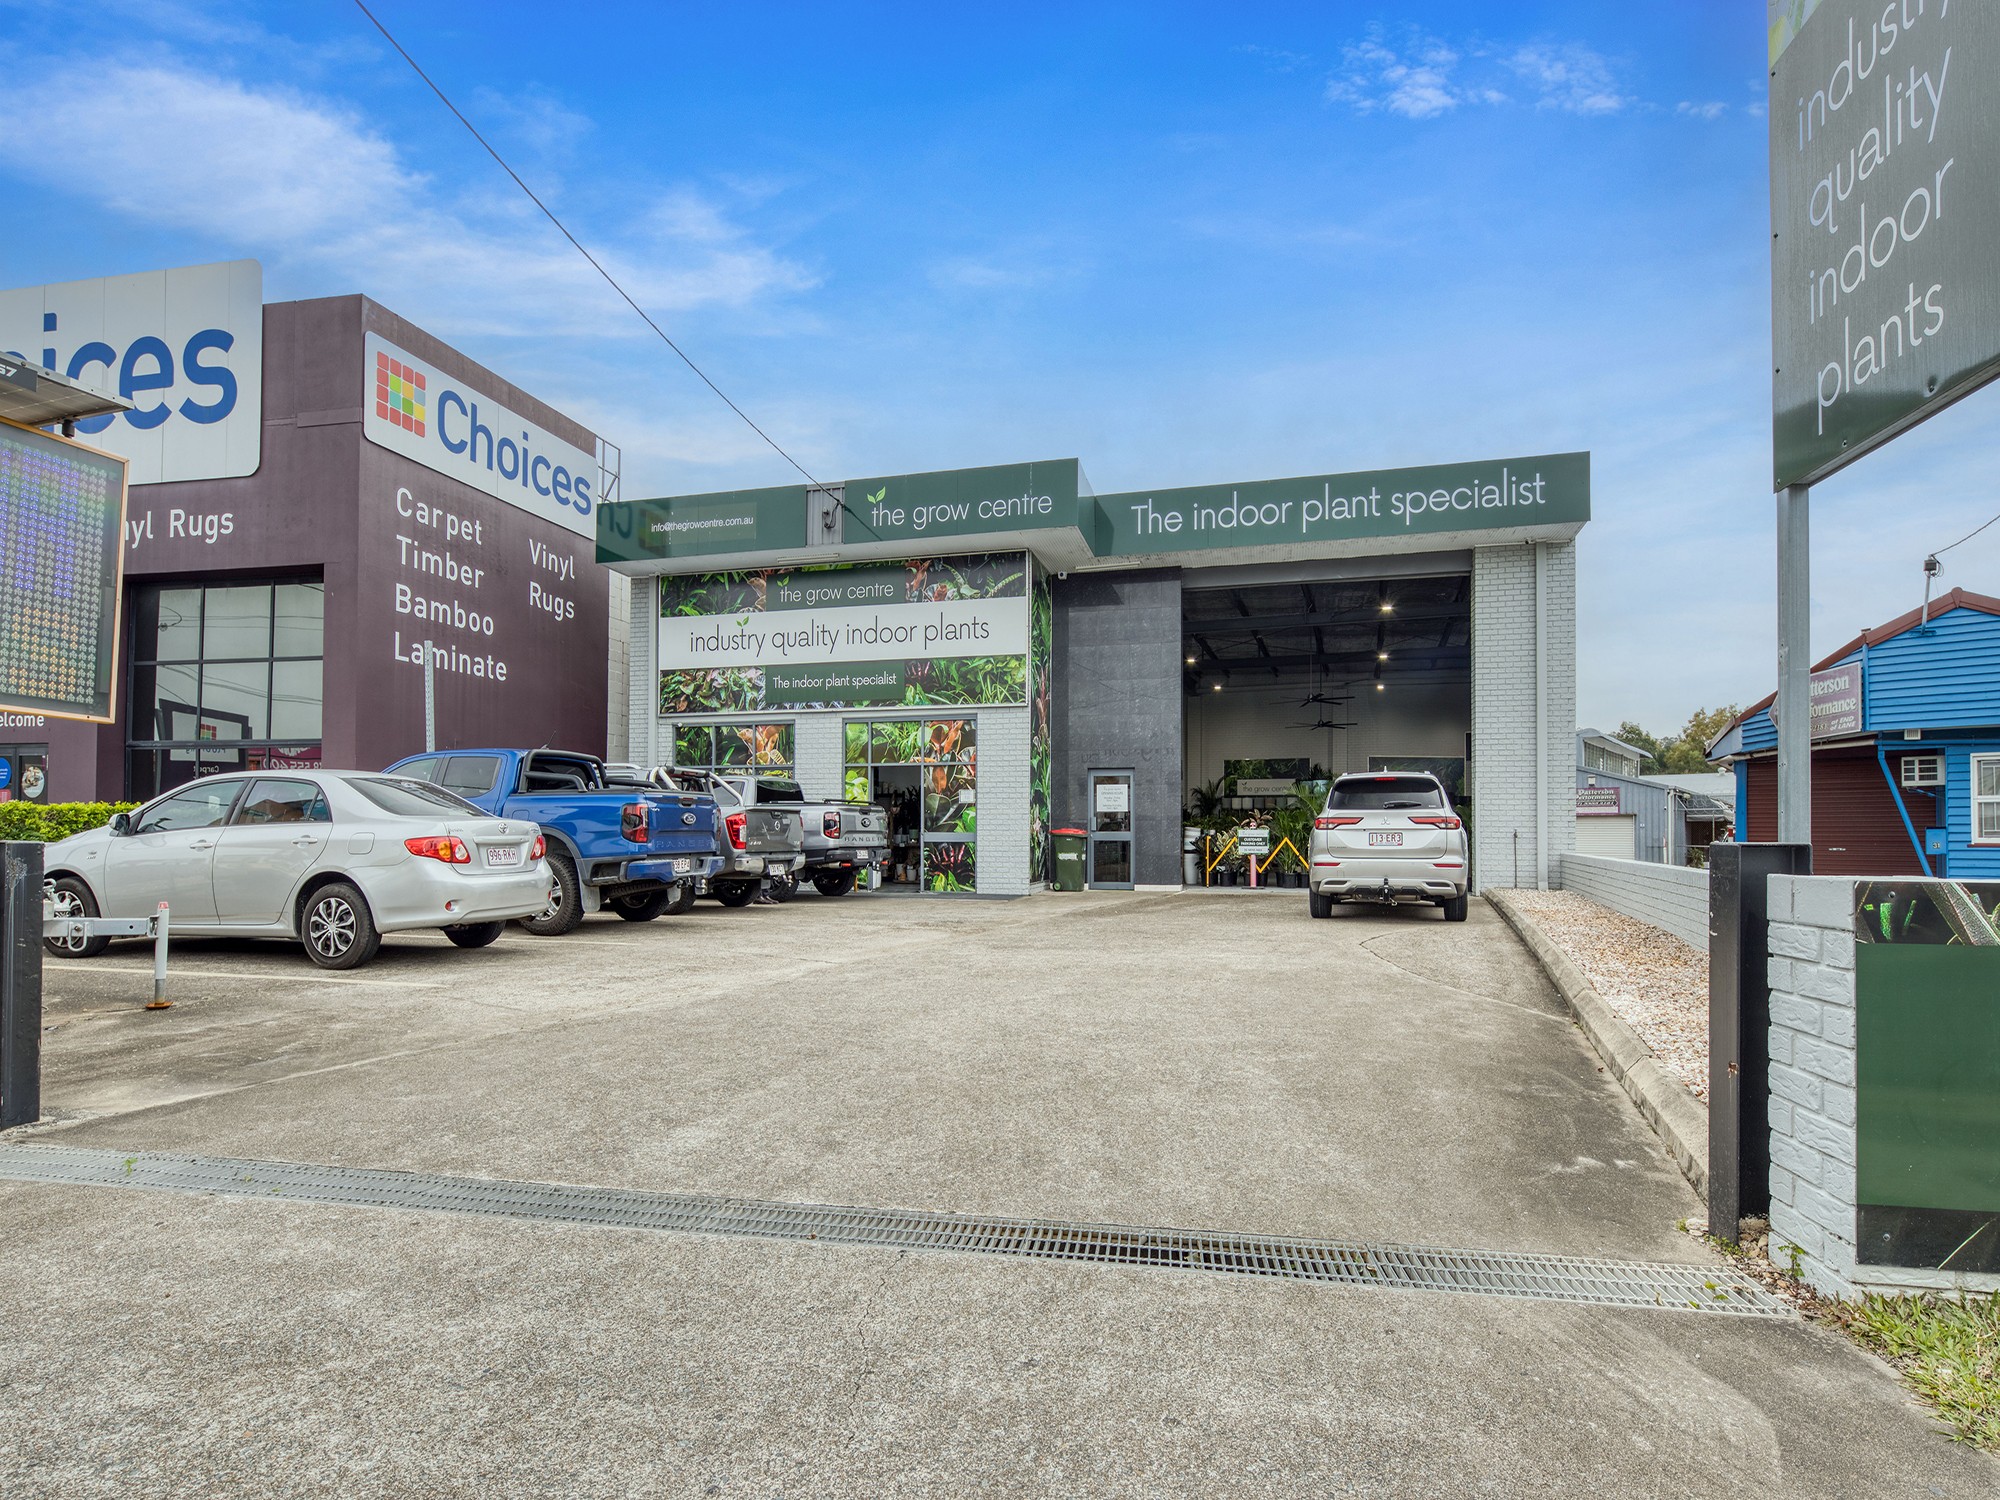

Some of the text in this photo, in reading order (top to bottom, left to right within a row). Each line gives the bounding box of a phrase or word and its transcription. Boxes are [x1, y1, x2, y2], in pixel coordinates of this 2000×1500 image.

[1809, 46, 1952, 233] quality
[1809, 157, 1954, 325] indoor
[4, 312, 238, 434] ices
[1817, 282, 1944, 436] plants
[437, 390, 592, 515] Choices
[396, 487, 482, 545] Carpet
[651, 516, 754, 533] info@thegrowcentre.com.au
[872, 492, 1053, 530] the grow centre
[1131, 467, 1546, 535] The indoor plant specialist
[169, 509, 234, 545] Rugs
[396, 534, 484, 588] Timber
[528, 538, 576, 581] Vinyl
[395, 583, 494, 636] Bamboo
[529, 581, 575, 622] Rugs
[779, 581, 894, 606] the grow centre
[394, 631, 508, 682] Laminate
[689, 612, 991, 658] industry quality indoor plants
[773, 671, 897, 689] The indoor plant specialist
[1577, 788, 1614, 796] Patterson
